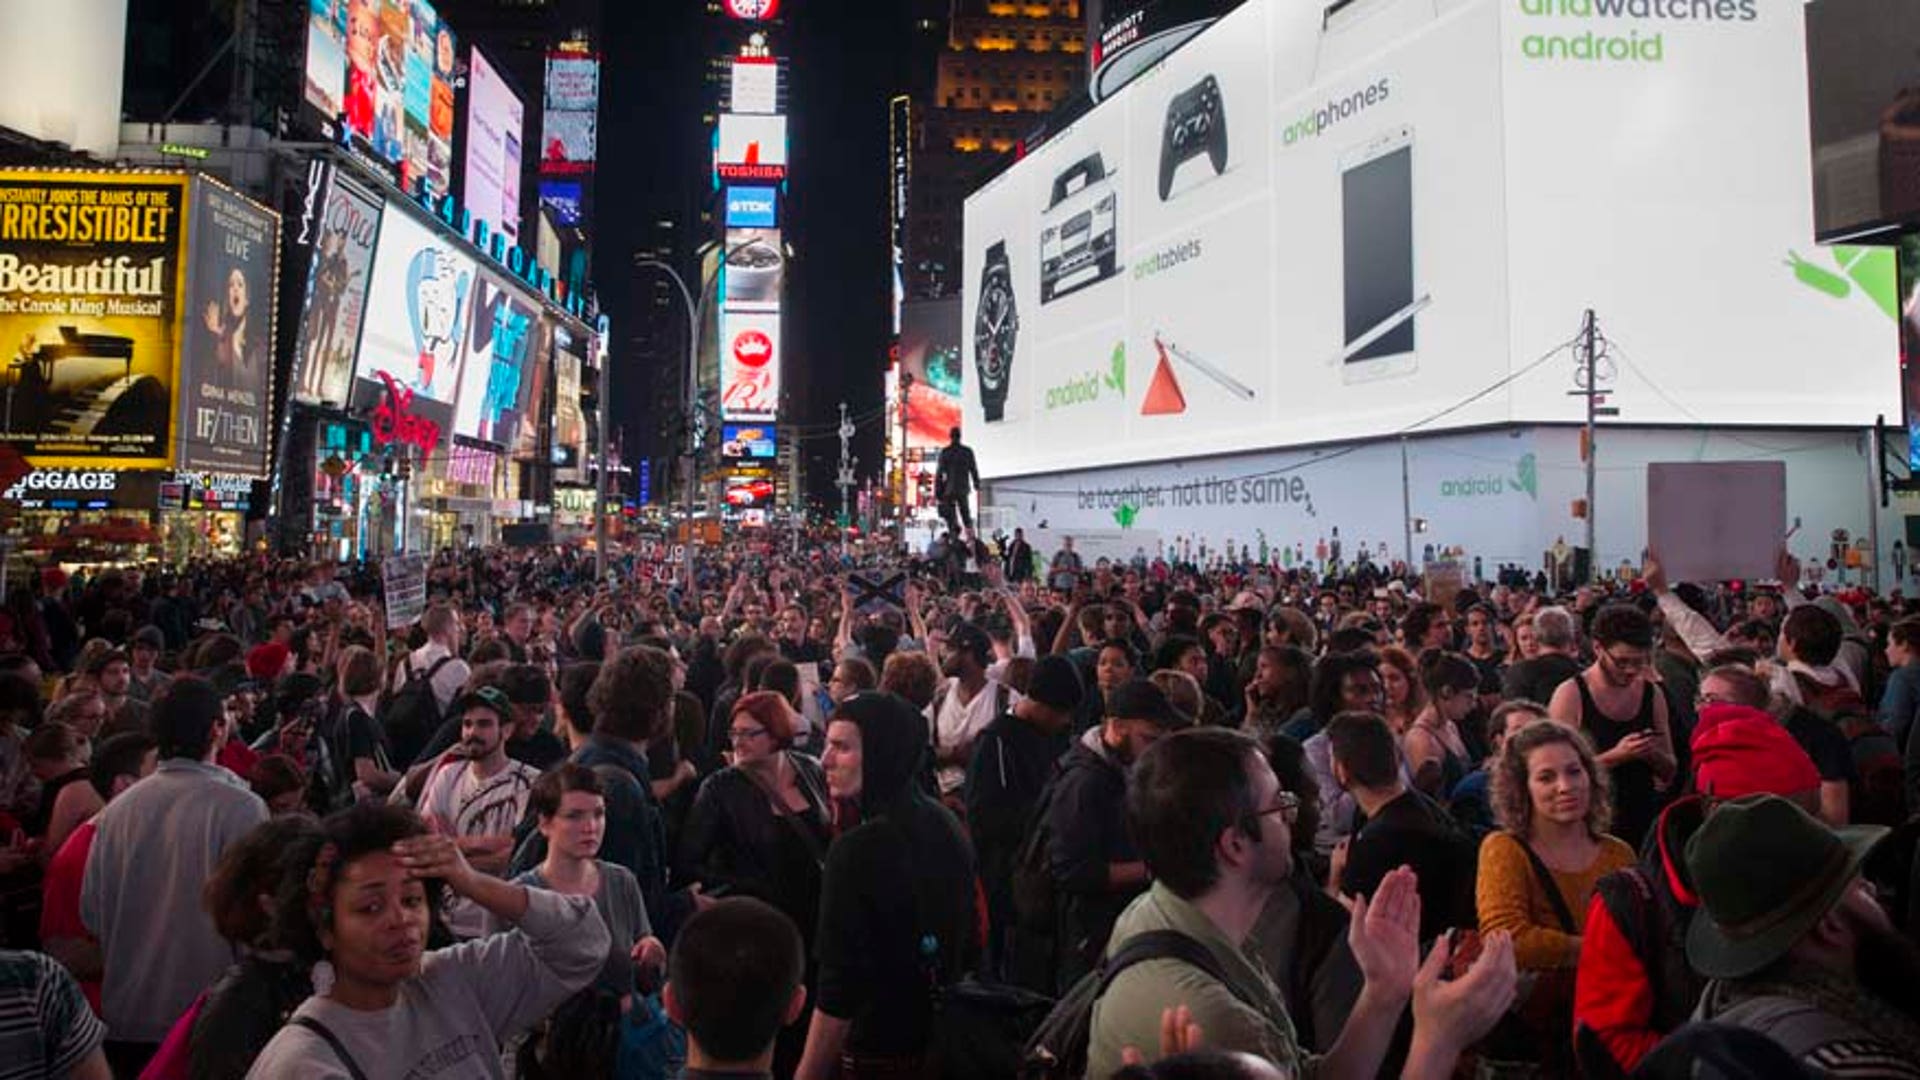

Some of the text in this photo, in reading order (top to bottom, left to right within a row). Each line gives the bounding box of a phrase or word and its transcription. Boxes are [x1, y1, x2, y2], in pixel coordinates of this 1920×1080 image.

[1102, 10, 1144, 43] MARRIOTT
[1520, 0, 1757, 21] andwatches
[1522, 31, 1663, 61] android
[1283, 78, 1389, 145] andphones
[718, 165, 784, 178] TOSHIBA
[0, 253, 165, 296] Beautiful
[1134, 240, 1202, 280] andtablets
[0, 296, 162, 317] he Carole King Musical
[1046, 369, 1099, 410] android
[197, 404, 259, 447] IF/THEN
[1078, 486, 1095, 510] be
[1172, 475, 1201, 507] not
[1204, 475, 1237, 505] the
[1441, 474, 1502, 496] android
